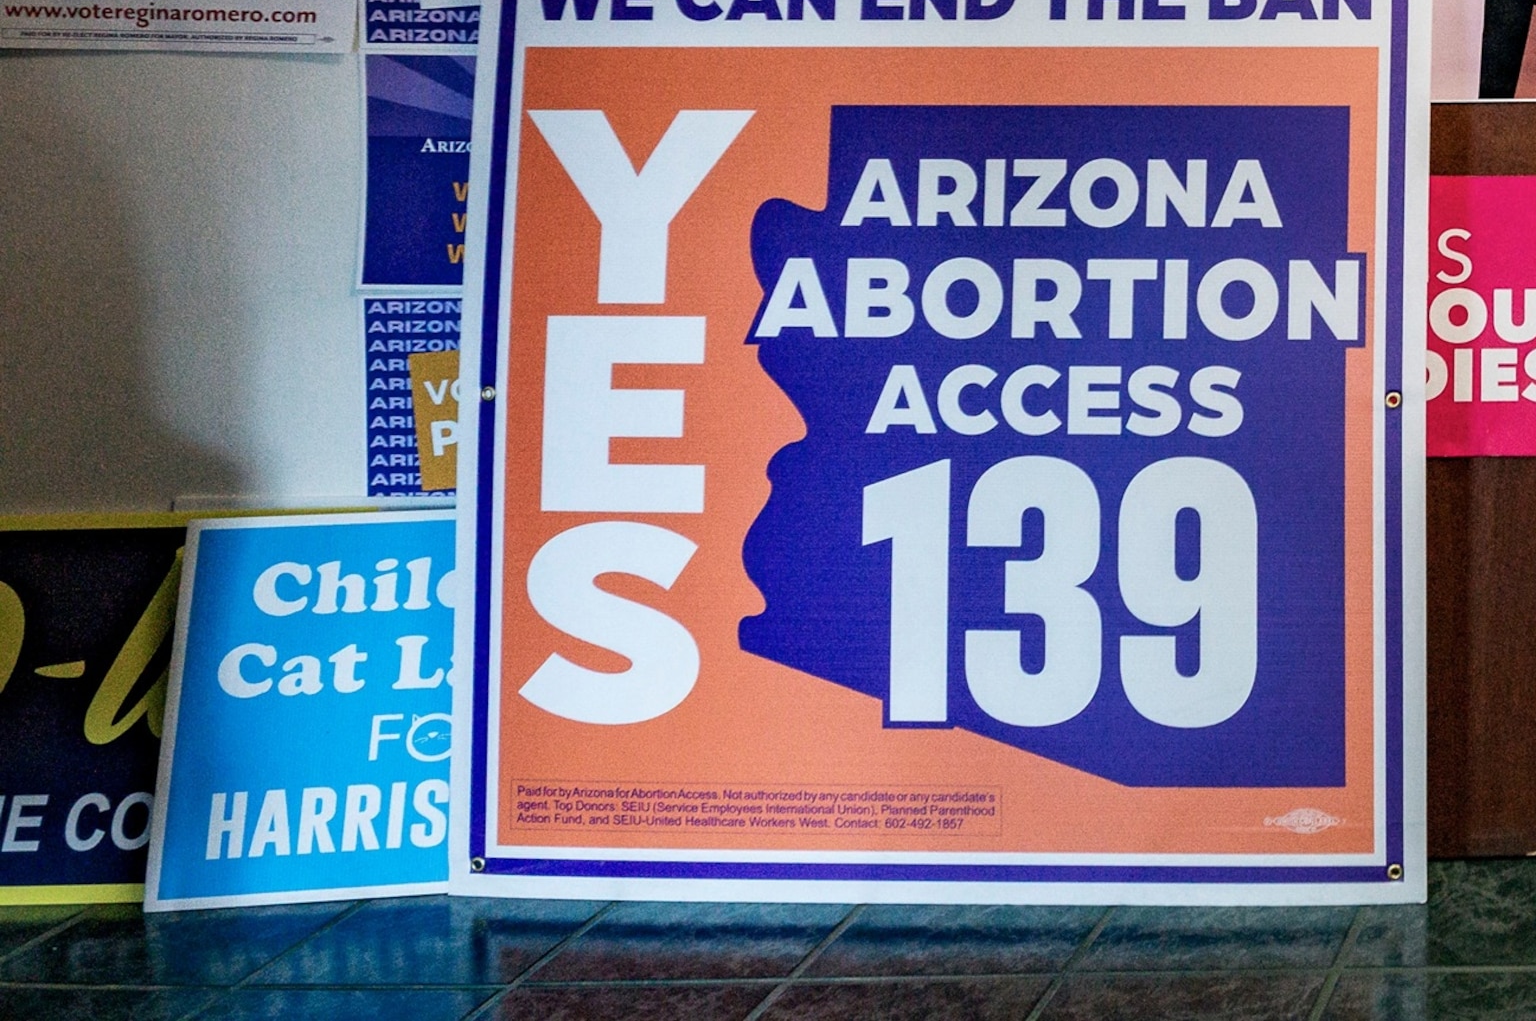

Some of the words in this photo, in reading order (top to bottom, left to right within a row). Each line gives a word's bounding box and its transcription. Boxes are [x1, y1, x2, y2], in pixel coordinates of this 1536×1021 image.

[5, 2, 316, 27] www.votereginaromero.com
[840, 157, 1284, 229] ARIZONA
[754, 255, 1360, 344] ABORTION
[518, 109, 757, 725] YES
[866, 363, 1244, 438] ACCESS
[862, 455, 1258, 729] 139
[217, 643, 368, 699] Cat
[204, 779, 450, 860] HARRIS
[517, 785, 542, 798] Paid
[543, 785, 557, 798] for
[558, 786, 572, 800] by
[572, 787, 615, 799] Arizona
[615, 787, 631, 799] for
[631, 788, 679, 799] Abortion
[723, 789, 742, 800] Not
[744, 790, 802, 802] authorized
[804, 791, 817, 804] by
[818, 793, 840, 804] any
[840, 791, 895, 802] candidate
[896, 794, 908, 802] or
[909, 794, 930, 805] any
[517, 814, 550, 824] Action
[588, 815, 609, 825] and
[612, 815, 682, 826] SEIU-United
[685, 816, 746, 827] Healthcare
[750, 817, 796, 828] Workers
[884, 819, 964, 830] 602-492-1857
[554, 801, 574, 814] Top
[621, 802, 650, 812] SEIU
[652, 802, 699, 813] (Service
[701, 803, 763, 816] Employees
[765, 805, 835, 815] International
[880, 806, 927, 816] Planned
[929, 806, 995, 816] Parenthood
